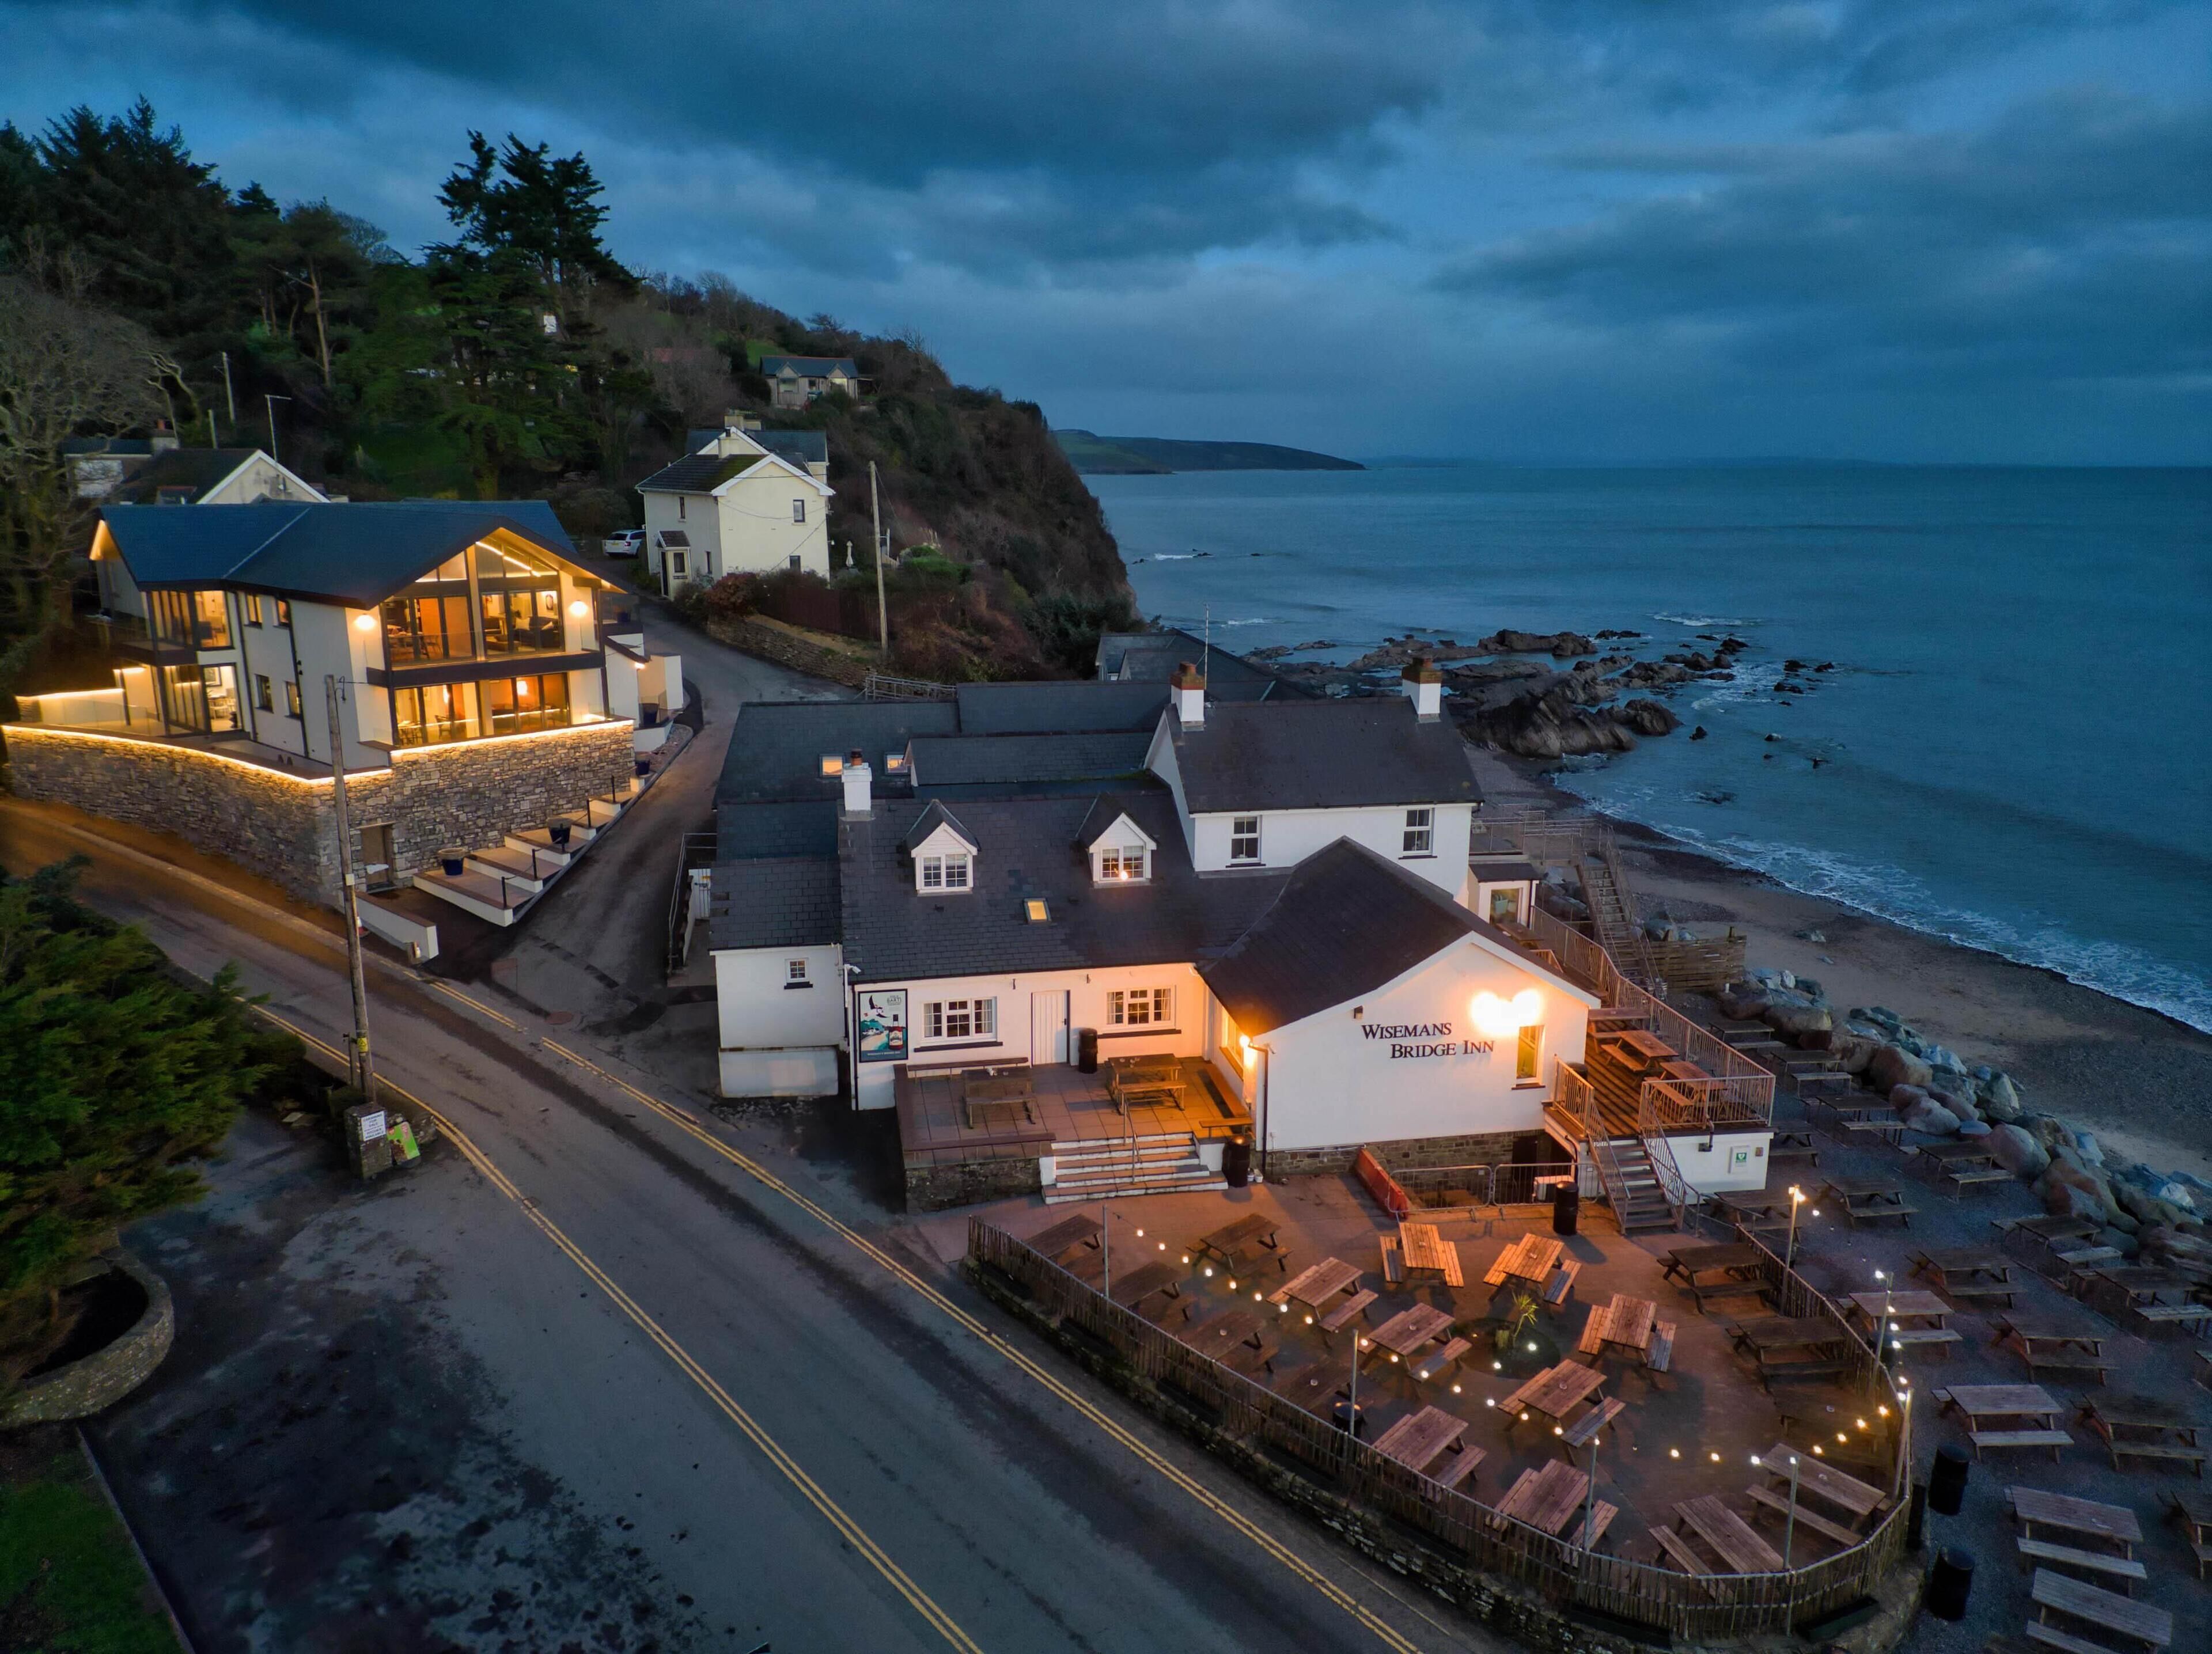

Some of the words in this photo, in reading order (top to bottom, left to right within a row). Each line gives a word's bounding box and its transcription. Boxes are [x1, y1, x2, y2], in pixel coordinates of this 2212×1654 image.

[1361, 1023, 1452, 1039] WISEMANS
[1390, 1043, 1456, 1059] BRIDGE
[1462, 1040, 1495, 1055] INN
